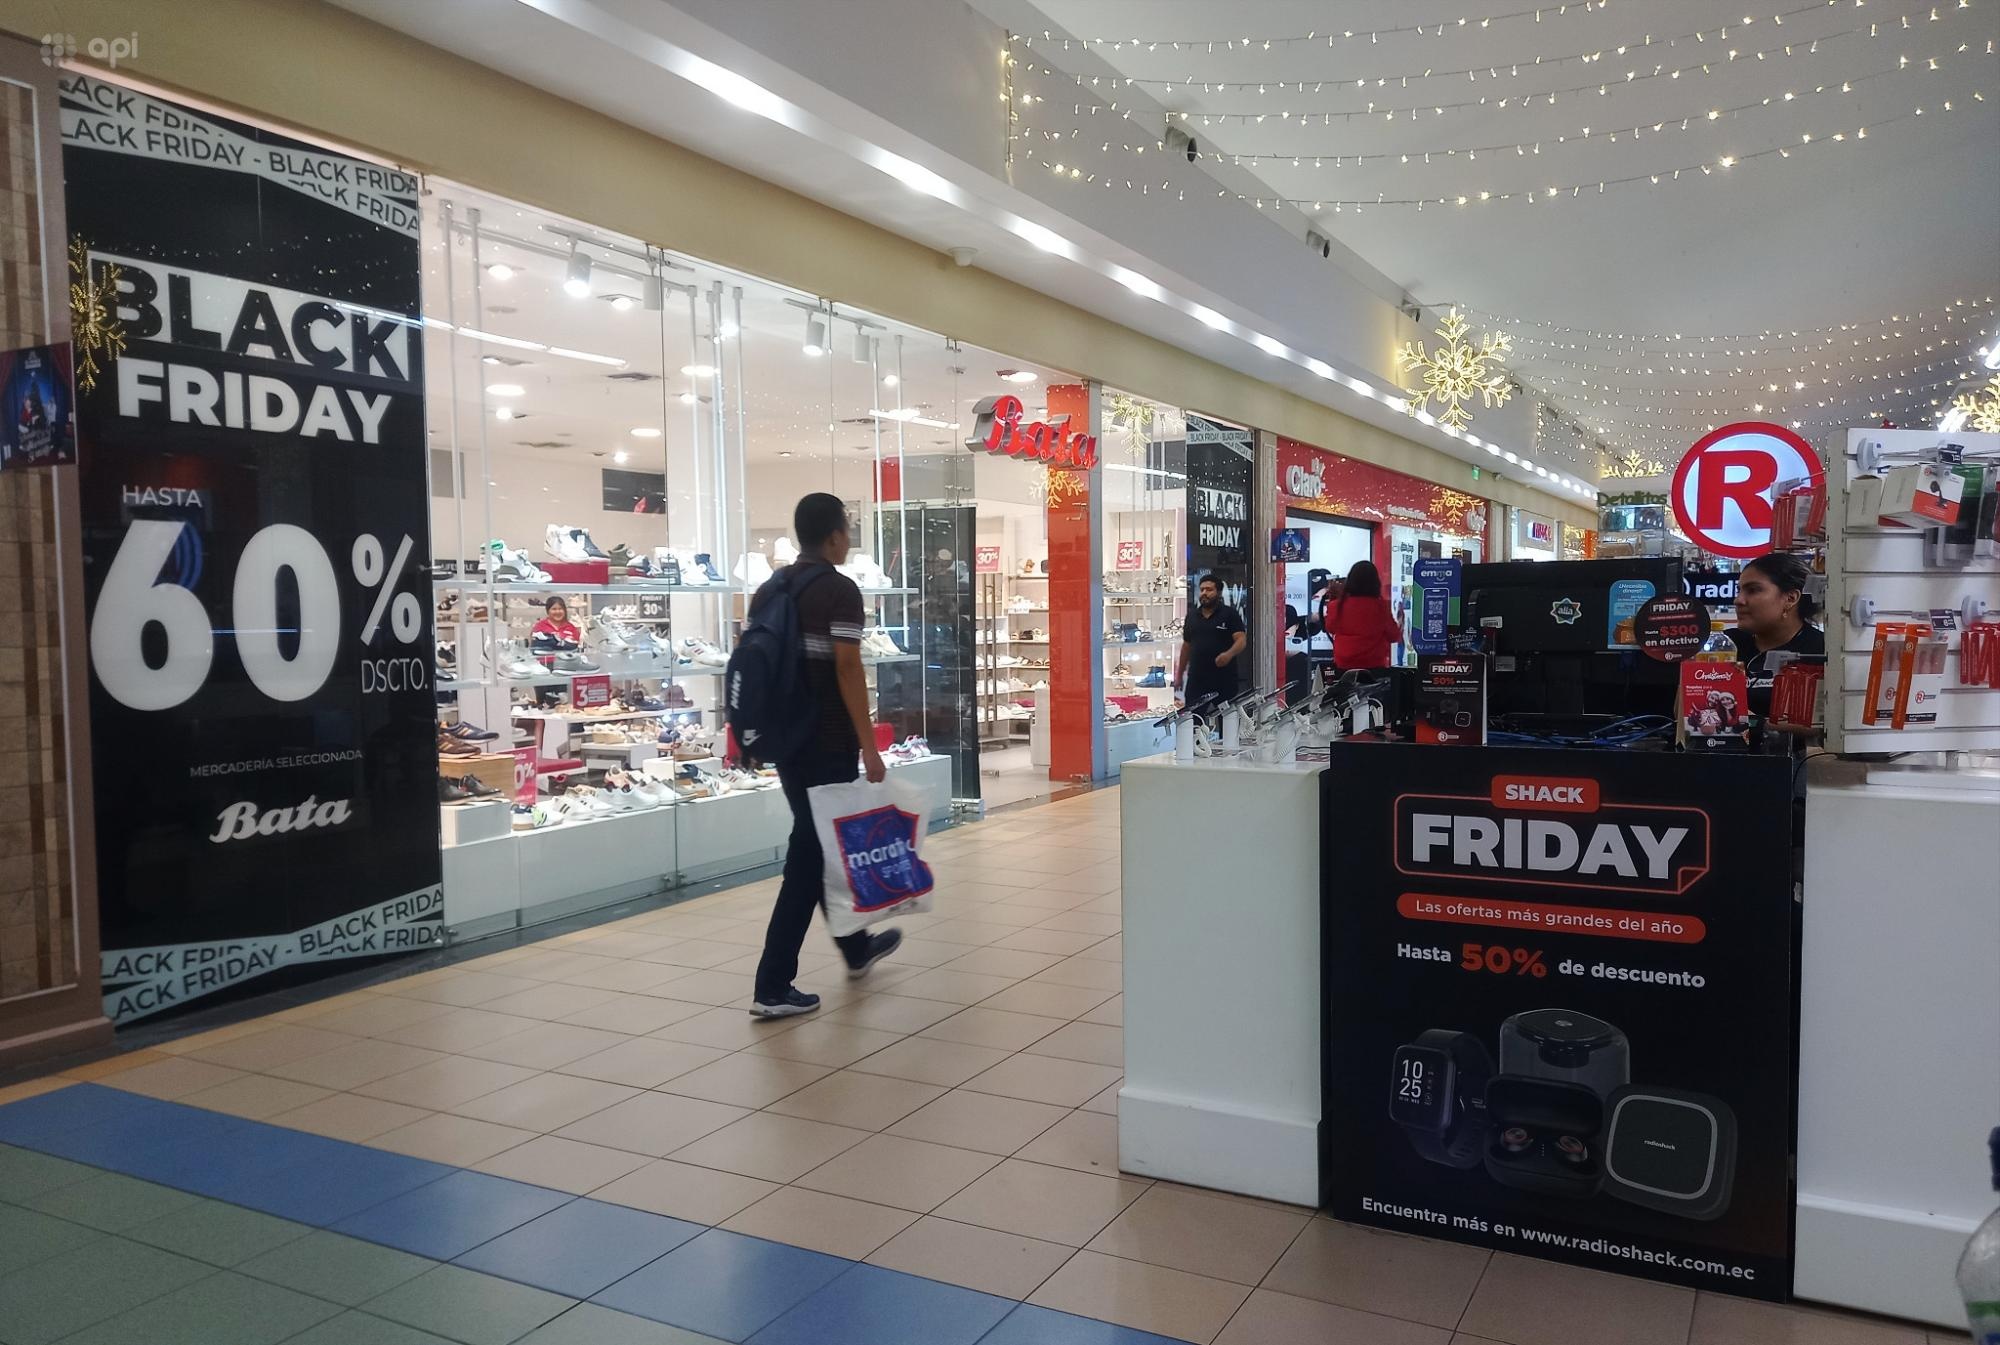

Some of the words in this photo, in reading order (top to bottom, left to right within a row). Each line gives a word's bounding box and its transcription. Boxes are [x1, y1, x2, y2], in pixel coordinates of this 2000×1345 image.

[146, 130, 245, 166] FRIDAY
[269, 152, 349, 184] BLACK
[91, 258, 407, 382] BLACK
[117, 356, 392, 444] FRIDAY
[978, 395, 1098, 470] Bata
[122, 485, 203, 508] HASTA
[1697, 450, 1778, 529] R
[1200, 523, 1240, 548] FRIDAY
[977, 552, 999, 565] 30%
[90, 520, 421, 711] 60%
[1653, 602, 1690, 612] FRIDAY
[1660, 624, 1699, 637] $300
[1660, 636, 1700, 646] efectivo
[361, 658, 428, 694] DSCTO.
[1432, 665, 1469, 673] FRIDAY
[276, 749, 364, 769] SELECCIONADA
[1504, 783, 1584, 805] SHACK
[209, 794, 352, 843] Bata
[1412, 813, 1689, 880] FRIDAY
[1416, 900, 1442, 914] Las
[1446, 902, 1502, 919] ofertas
[1508, 908, 1540, 922] más
[1545, 911, 1613, 929] grandes
[1618, 917, 1645, 932] del
[1651, 920, 1684, 935] año
[183, 944, 278, 995] FRIDAY
[300, 911, 377, 954] BLACK
[1397, 943, 1451, 962] Hasta
[1461, 943, 1548, 978] 50%
[1558, 959, 1585, 976] de
[1591, 962, 1706, 988] descuento
[1403, 1059, 1423, 1079] 10
[1400, 1077, 1422, 1098] 25
[1362, 1197, 1447, 1225] Encuentra
[1453, 1216, 1488, 1232] más
[1494, 1223, 1515, 1238] en
[1521, 1226, 1755, 1281] www.radioshack.com.ec
